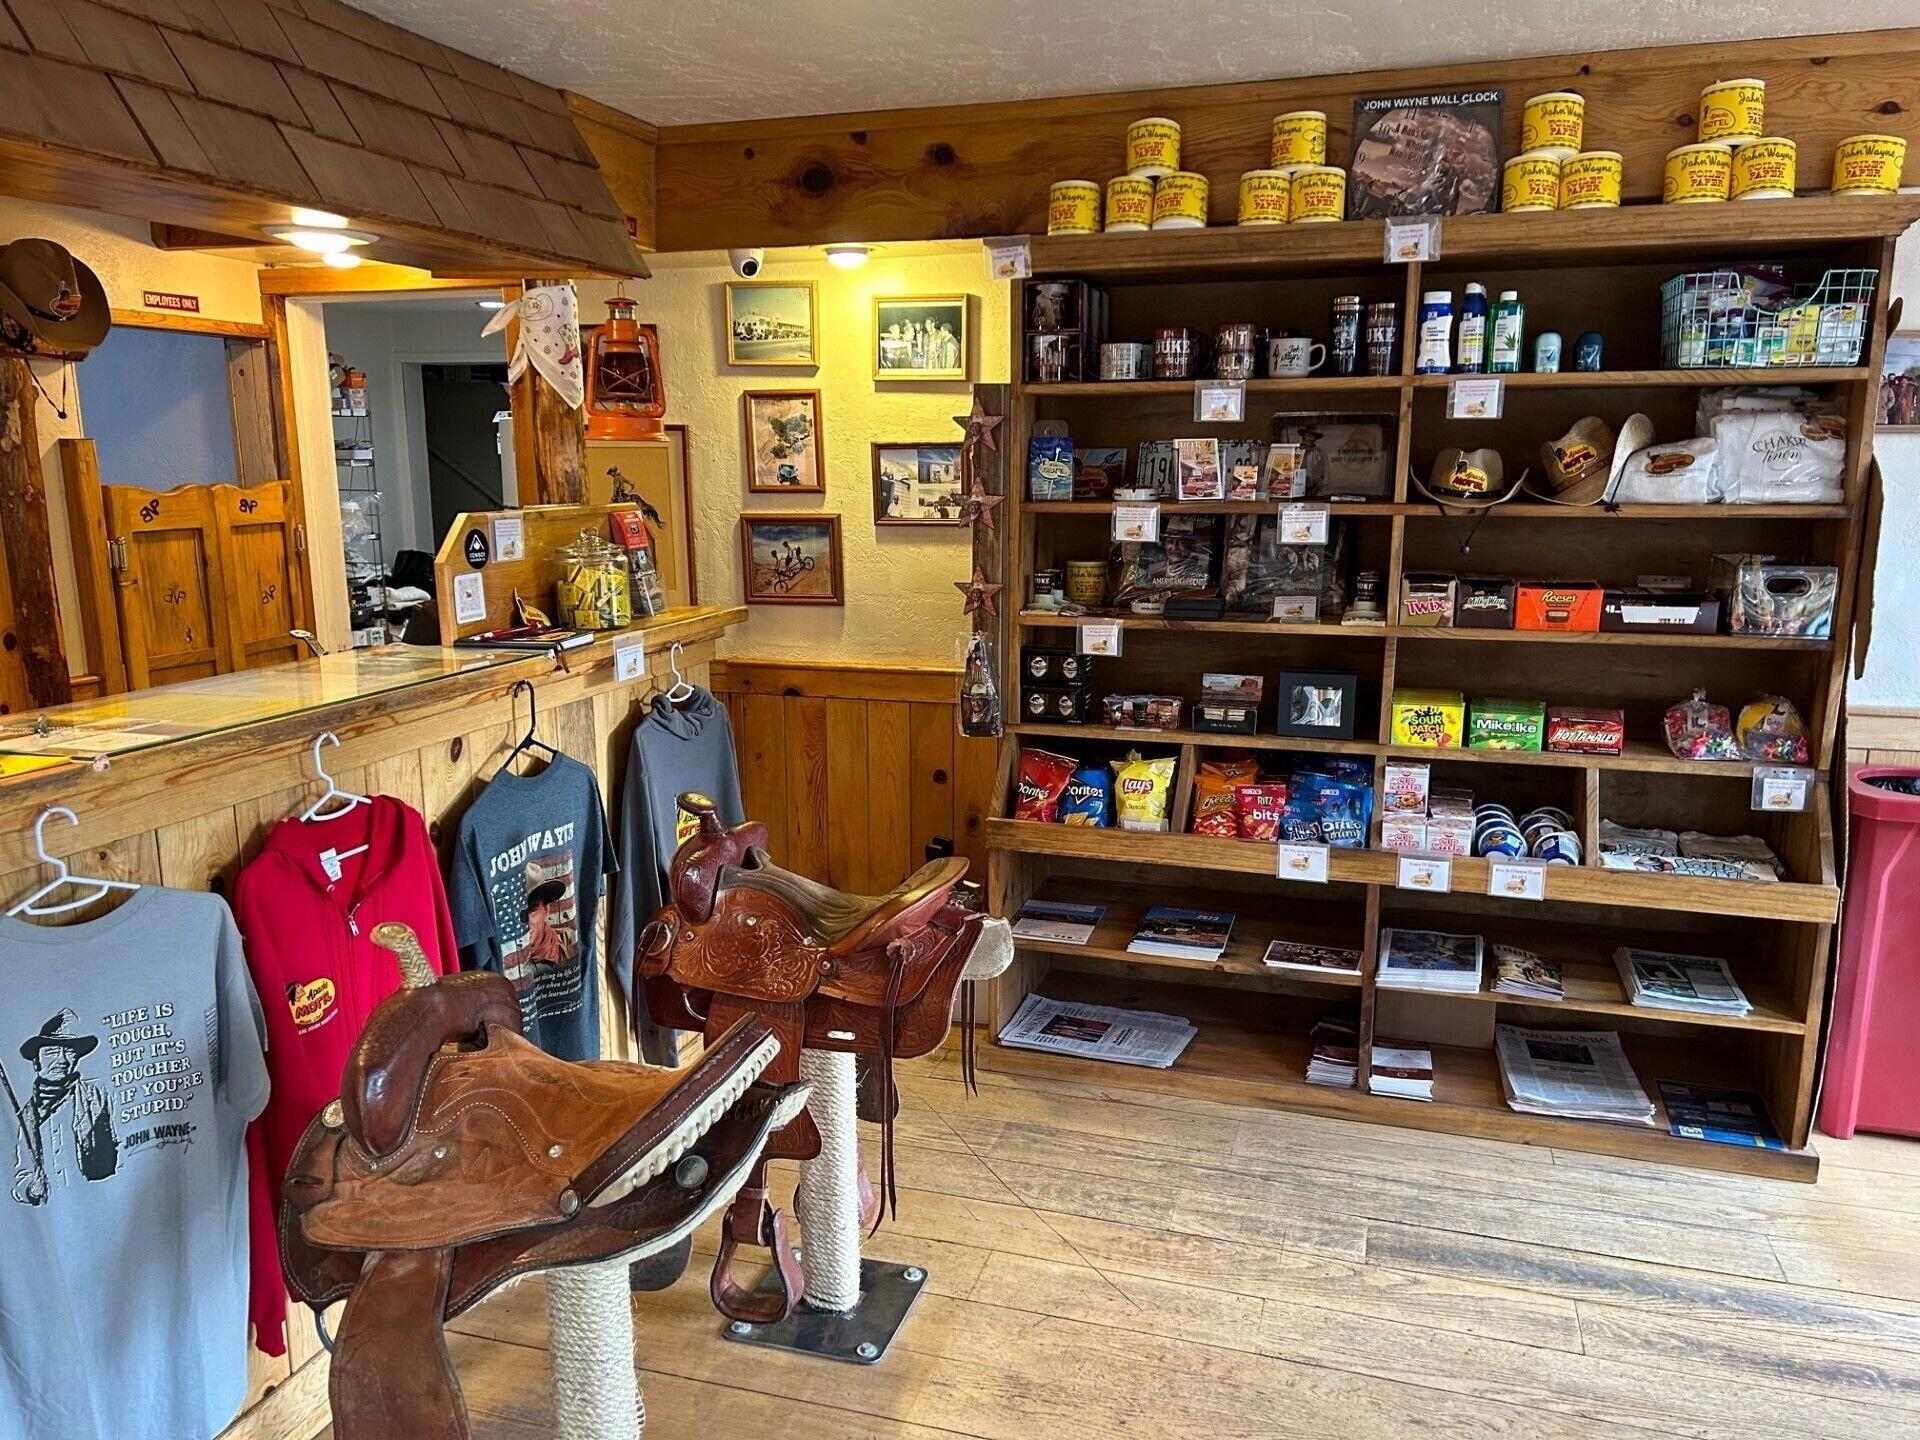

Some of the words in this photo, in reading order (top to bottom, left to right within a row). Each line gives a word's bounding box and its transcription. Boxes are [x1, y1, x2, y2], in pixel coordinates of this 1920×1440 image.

[1364, 100, 1391, 110] JOHN
[1394, 97, 1429, 108] WAYNE
[1431, 94, 1459, 106] WALL
[1461, 91, 1498, 104] CLOCK
[1738, 91, 1761, 105] John
[1541, 105, 1565, 119] John
[1565, 104, 1582, 120] Way
[1747, 106, 1763, 116] TOI
[1704, 119, 1729, 129] MOTEL
[1748, 116, 1763, 127] PAP
[1145, 128, 1172, 141] Wayne
[1133, 142, 1165, 150] TOILET
[1135, 149, 1162, 159] PAPER
[1741, 149, 1766, 166] John
[1765, 147, 1793, 161] Wayne
[1840, 146, 1863, 163] John
[1863, 144, 1895, 159] Wayne
[1581, 162, 1612, 176] Wayne
[1681, 155, 1707, 171] John
[1747, 162, 1786, 171] TOILET
[1845, 160, 1886, 170] TOILET
[1521, 165, 1544, 179] John
[1544, 164, 1560, 181] Way
[1689, 170, 1726, 180] TOILET
[1749, 169, 1784, 180] PAPER
[1845, 168, 1881, 179] PAPER
[1299, 180, 1318, 193] John
[1319, 178, 1343, 191] Wayne
[1566, 176, 1603, 186] TOILET
[1690, 178, 1723, 188] PAPER
[1110, 183, 1130, 197] John
[1166, 182, 1193, 195] Wayne
[1248, 181, 1269, 195] John
[1567, 184, 1600, 197] PAPER
[1116, 198, 1147, 206] TOILET
[1254, 194, 1285, 203] TOILET
[1304, 191, 1337, 200] TOILET
[1117, 205, 1145, 214] PAPER
[1255, 202, 1283, 211] PAPER
[1305, 199, 1334, 208] PAPER
[145, 293, 181, 308] EMPLOYEES
[181, 298, 197, 310] ONLY
[1366, 327, 1396, 343] UKE
[1035, 577, 1050, 585] UKE
[1357, 582, 1373, 590] UKE
[1410, 714, 1443, 725] SOUR
[1476, 718, 1510, 731] Mike
[1409, 725, 1444, 735] PATCH
[1553, 728, 1577, 741] HOT
[1576, 731, 1619, 744] TAMALES
[1257, 796, 1274, 806] RITZ
[1253, 809, 1280, 822] bits
[1322, 820, 1362, 832] OREO
[155, 1003, 173, 1019] IS
[109, 1023, 172, 1049] TOUGH,
[111, 1046, 145, 1068] BUT
[150, 1039, 186, 1057] IT'S
[112, 1057, 192, 1088] TOUGHER
[120, 1087, 137, 1105] IF
[142, 1071, 203, 1097] YOU'RE
[124, 1127, 150, 1149] JOHN
[153, 1121, 191, 1139] WAYNE
